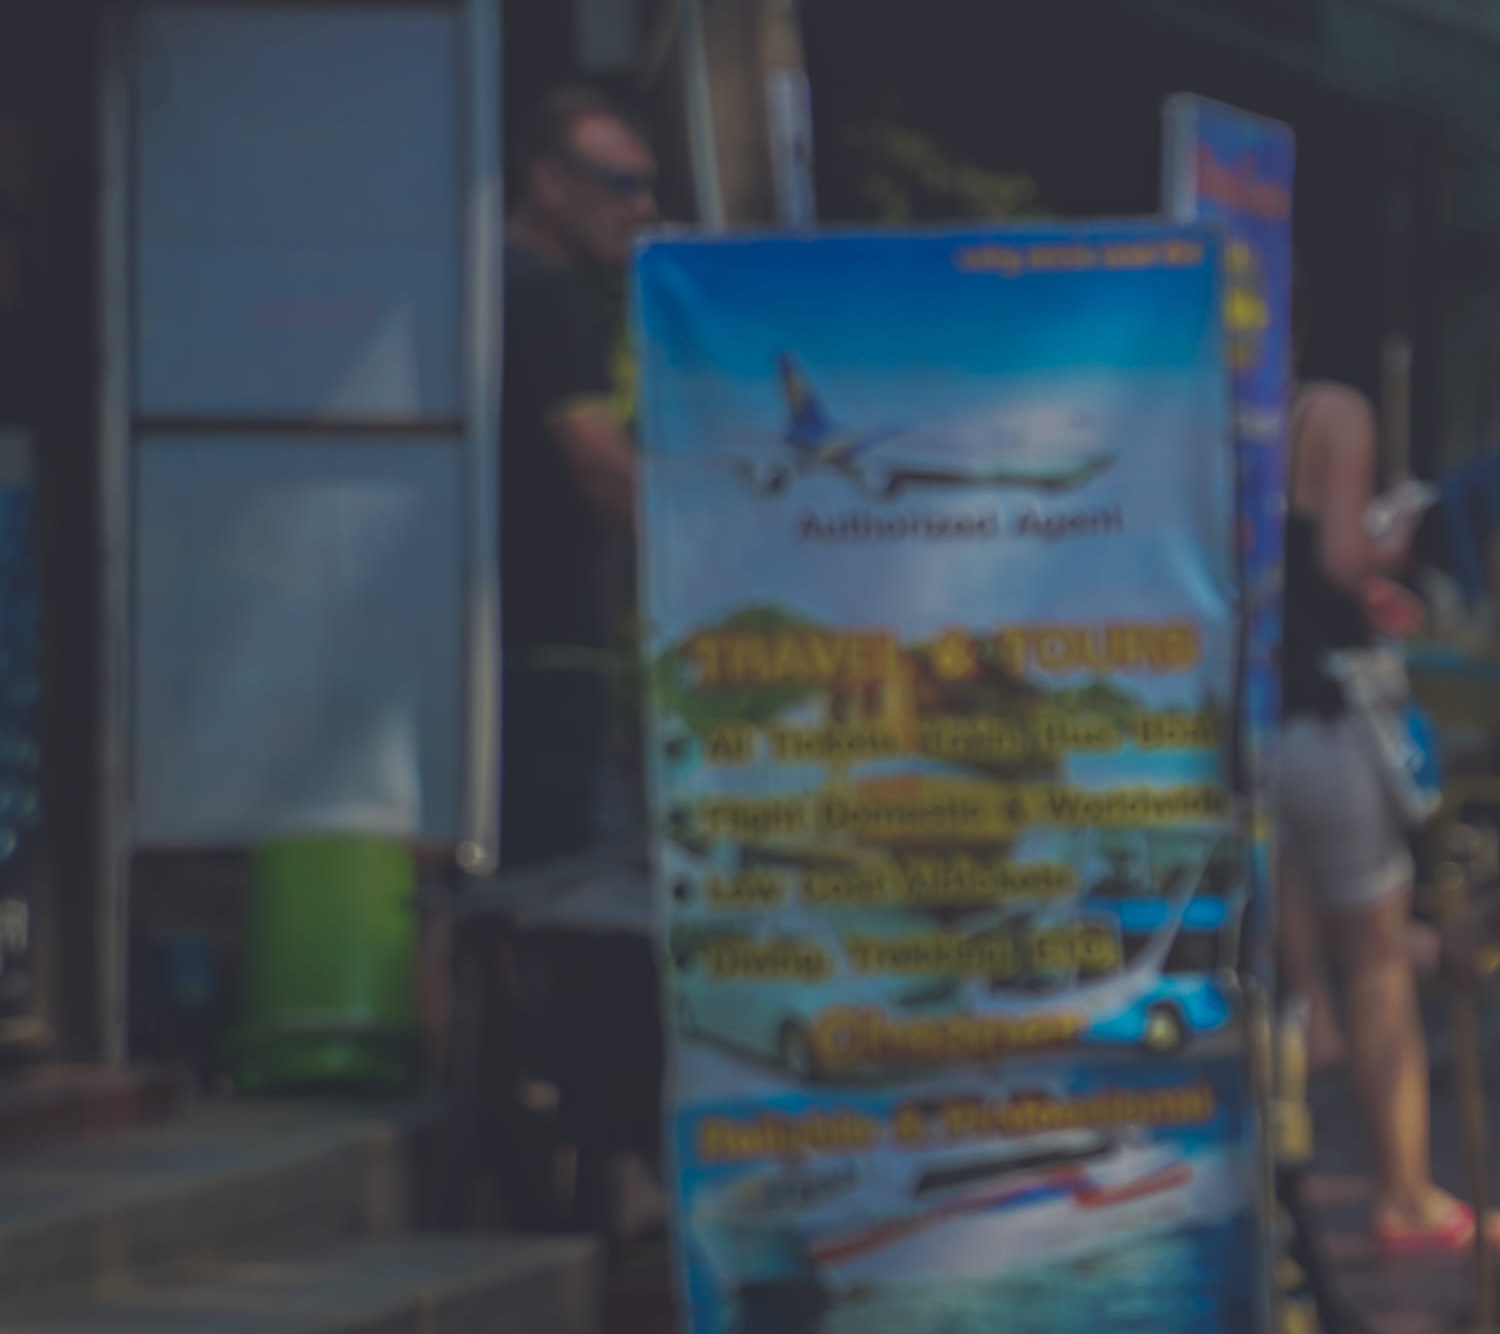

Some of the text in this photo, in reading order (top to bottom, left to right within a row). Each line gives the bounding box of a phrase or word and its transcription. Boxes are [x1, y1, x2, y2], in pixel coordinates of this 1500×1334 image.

[1015, 503, 1124, 546] Agent
[690, 629, 908, 685] TRAVEL
[1001, 619, 1203, 673] TOURS
[810, 1004, 1090, 1066] Cheaper
